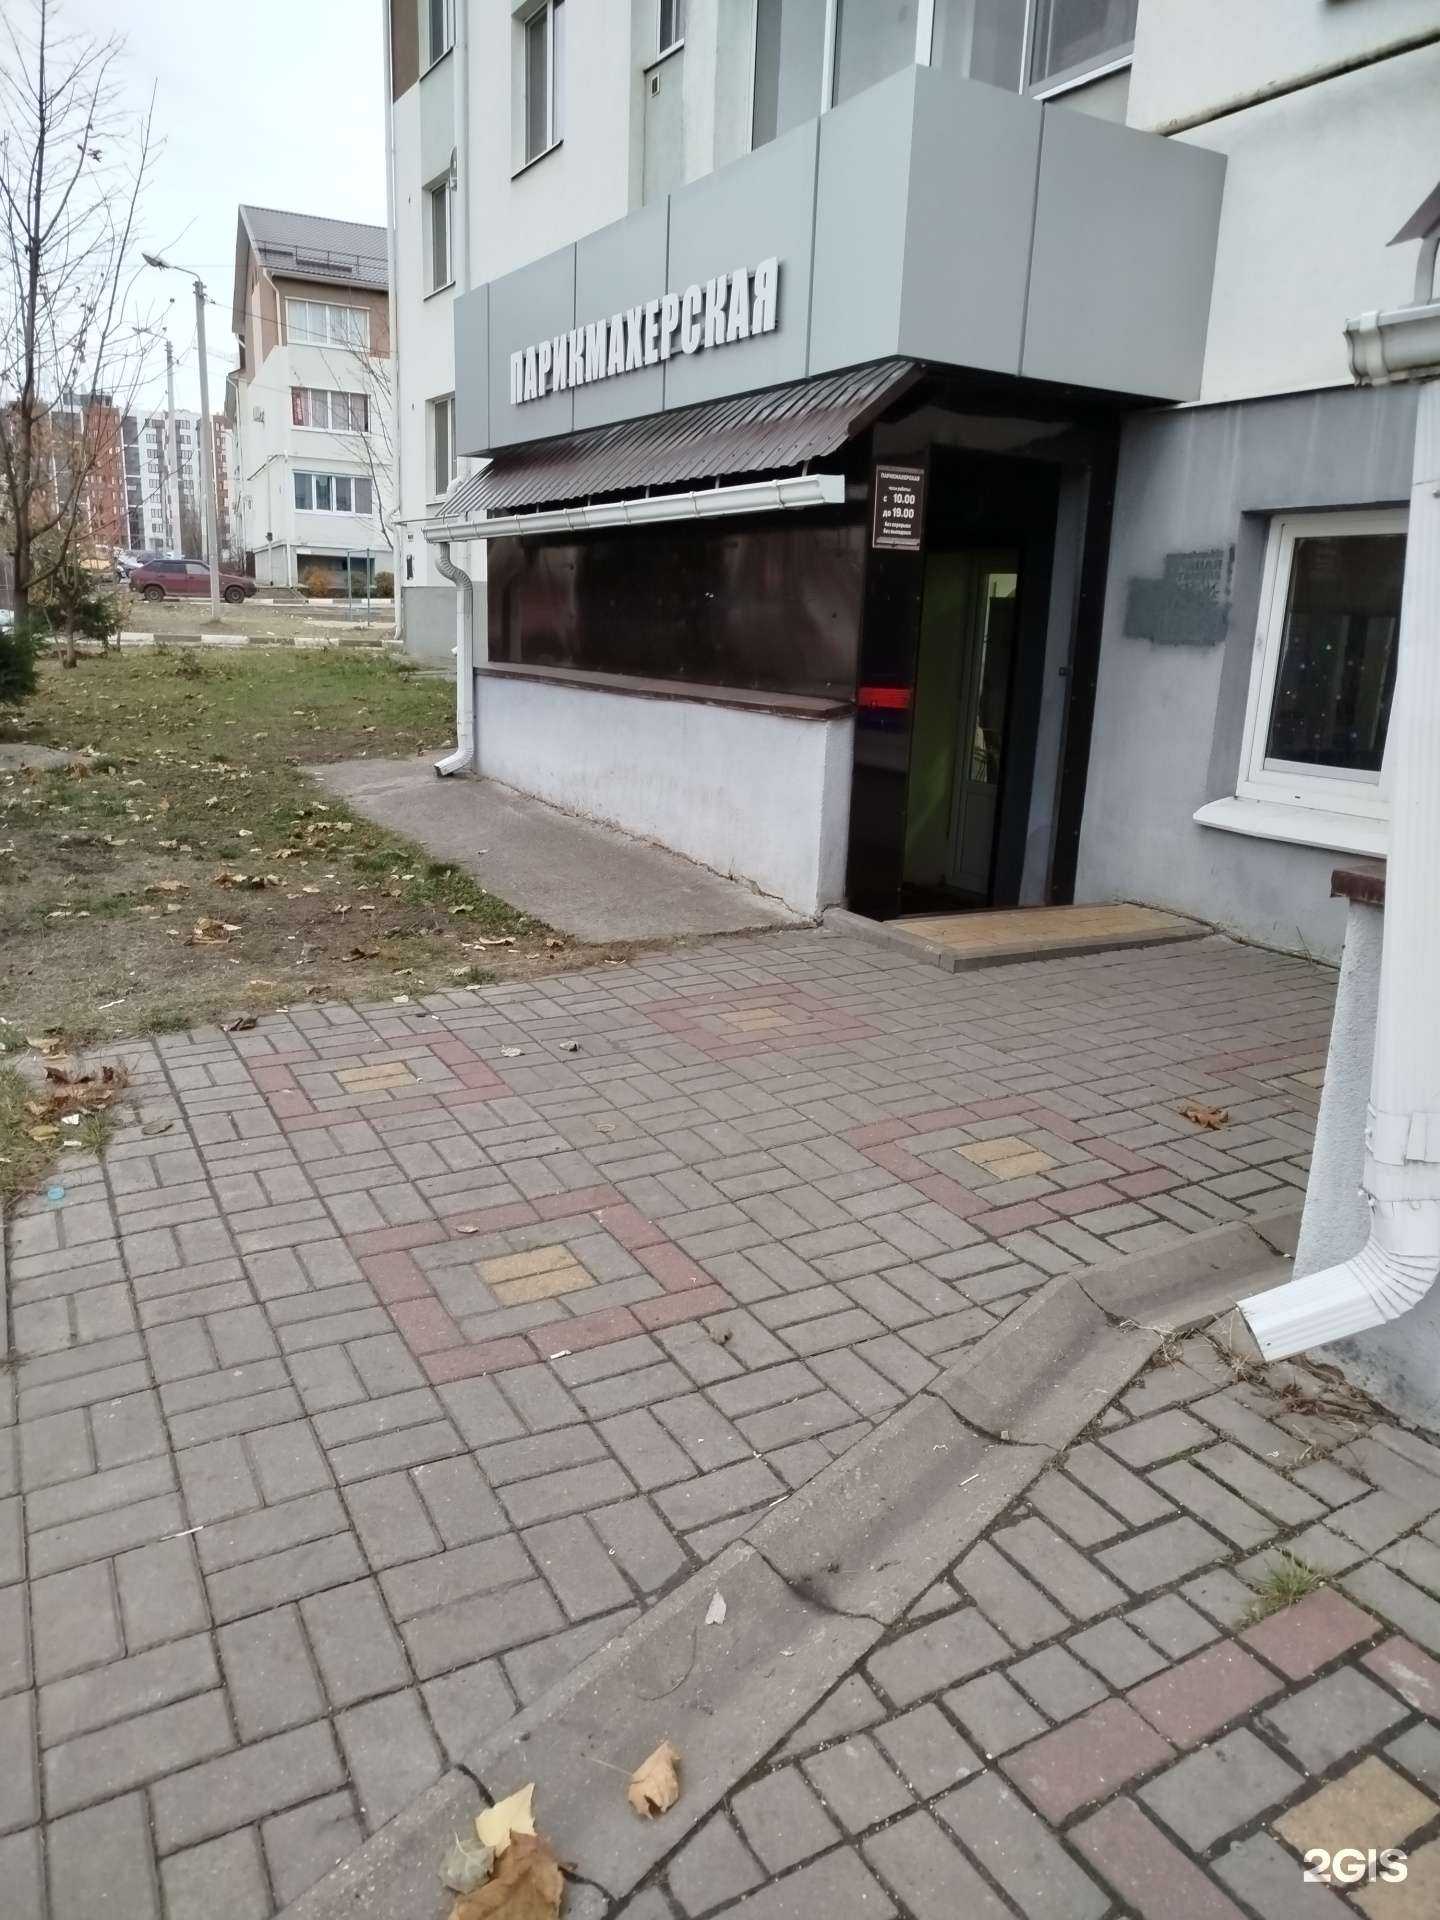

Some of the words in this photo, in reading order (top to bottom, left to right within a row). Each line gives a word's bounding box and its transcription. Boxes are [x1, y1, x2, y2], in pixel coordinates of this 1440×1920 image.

[510, 256, 778, 405] ПАРИКМАХЕРСКАЯ
[880, 472, 920, 482] ПАРИКМАХЕРСКАЯ
[893, 493, 915, 504] 10.00
[882, 510, 891, 518] до
[892, 507, 915, 519] 19.00
